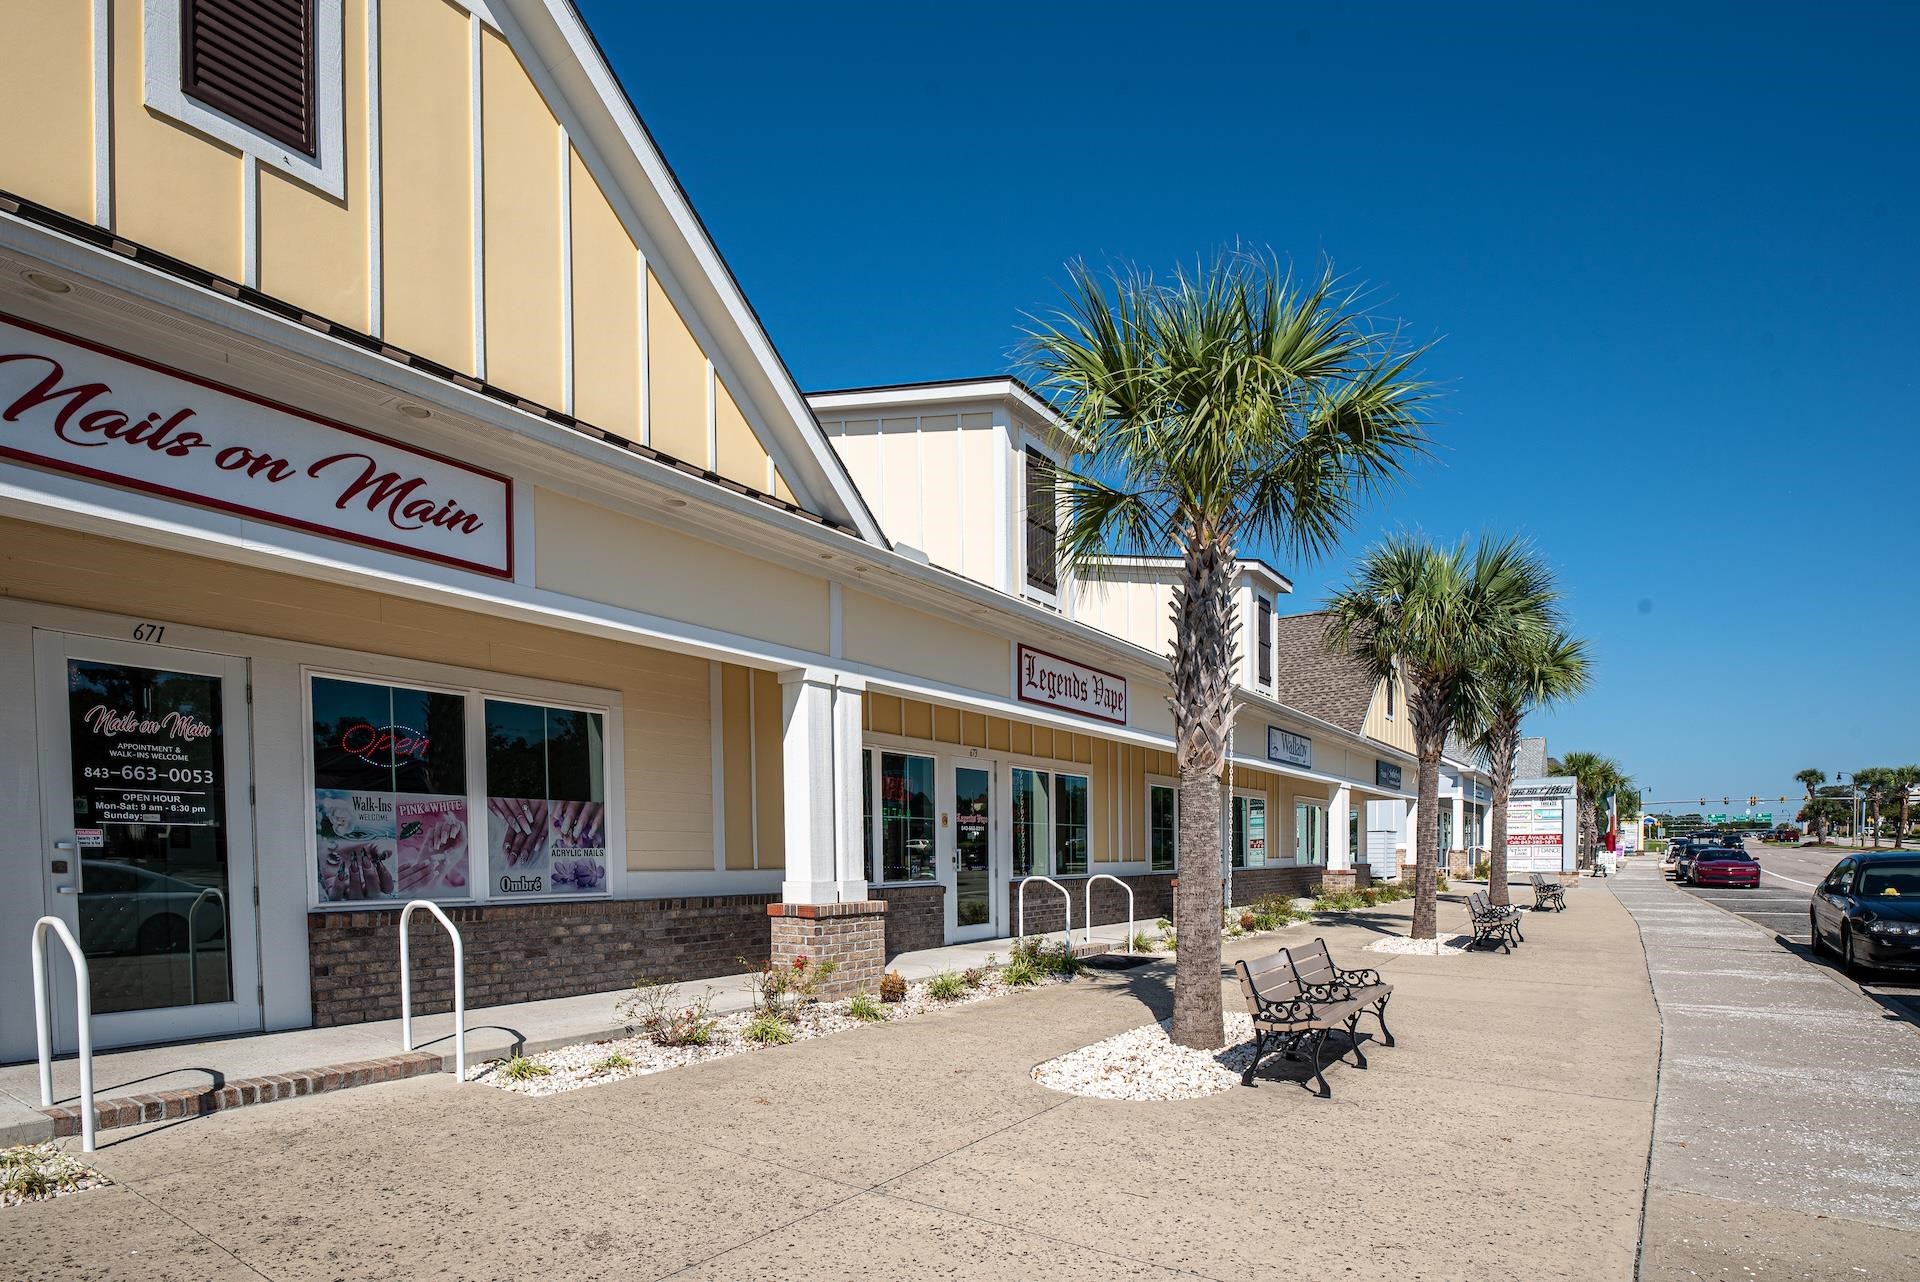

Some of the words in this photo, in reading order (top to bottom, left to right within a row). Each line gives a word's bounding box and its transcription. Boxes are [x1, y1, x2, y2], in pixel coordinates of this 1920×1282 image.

[0, 354, 211, 457] Nails
[215, 446, 297, 482] on
[307, 453, 484, 534] Main
[133, 623, 165, 643] 671
[1024, 653, 1088, 702] Legends
[1093, 675, 1124, 714] Vape
[84, 705, 139, 737] Nails
[139, 722, 160, 734] on
[162, 711, 211, 742] Main
[118, 743, 173, 753] APPOINTMENT
[342, 724, 430, 758] Open
[1281, 733, 1307, 763] Wallaby
[109, 750, 150, 759] WALK-INS
[151, 752, 189, 762] WELCOME
[84, 765, 214, 784] 843-663-0053
[122, 793, 150, 802] OPEN
[153, 795, 181, 803] HOUR
[352, 796, 392, 812] Walk-Ins
[95, 801, 138, 811] Mon-Sat:
[171, 804, 190, 812] 6:30
[399, 802, 424, 816] PINK
[429, 800, 463, 813] WHITE
[103, 811, 143, 821] Sunday:
[551, 849, 582, 857] ACRYLIC
[584, 848, 604, 857] NAILS
[500, 875, 542, 892] Ombré
